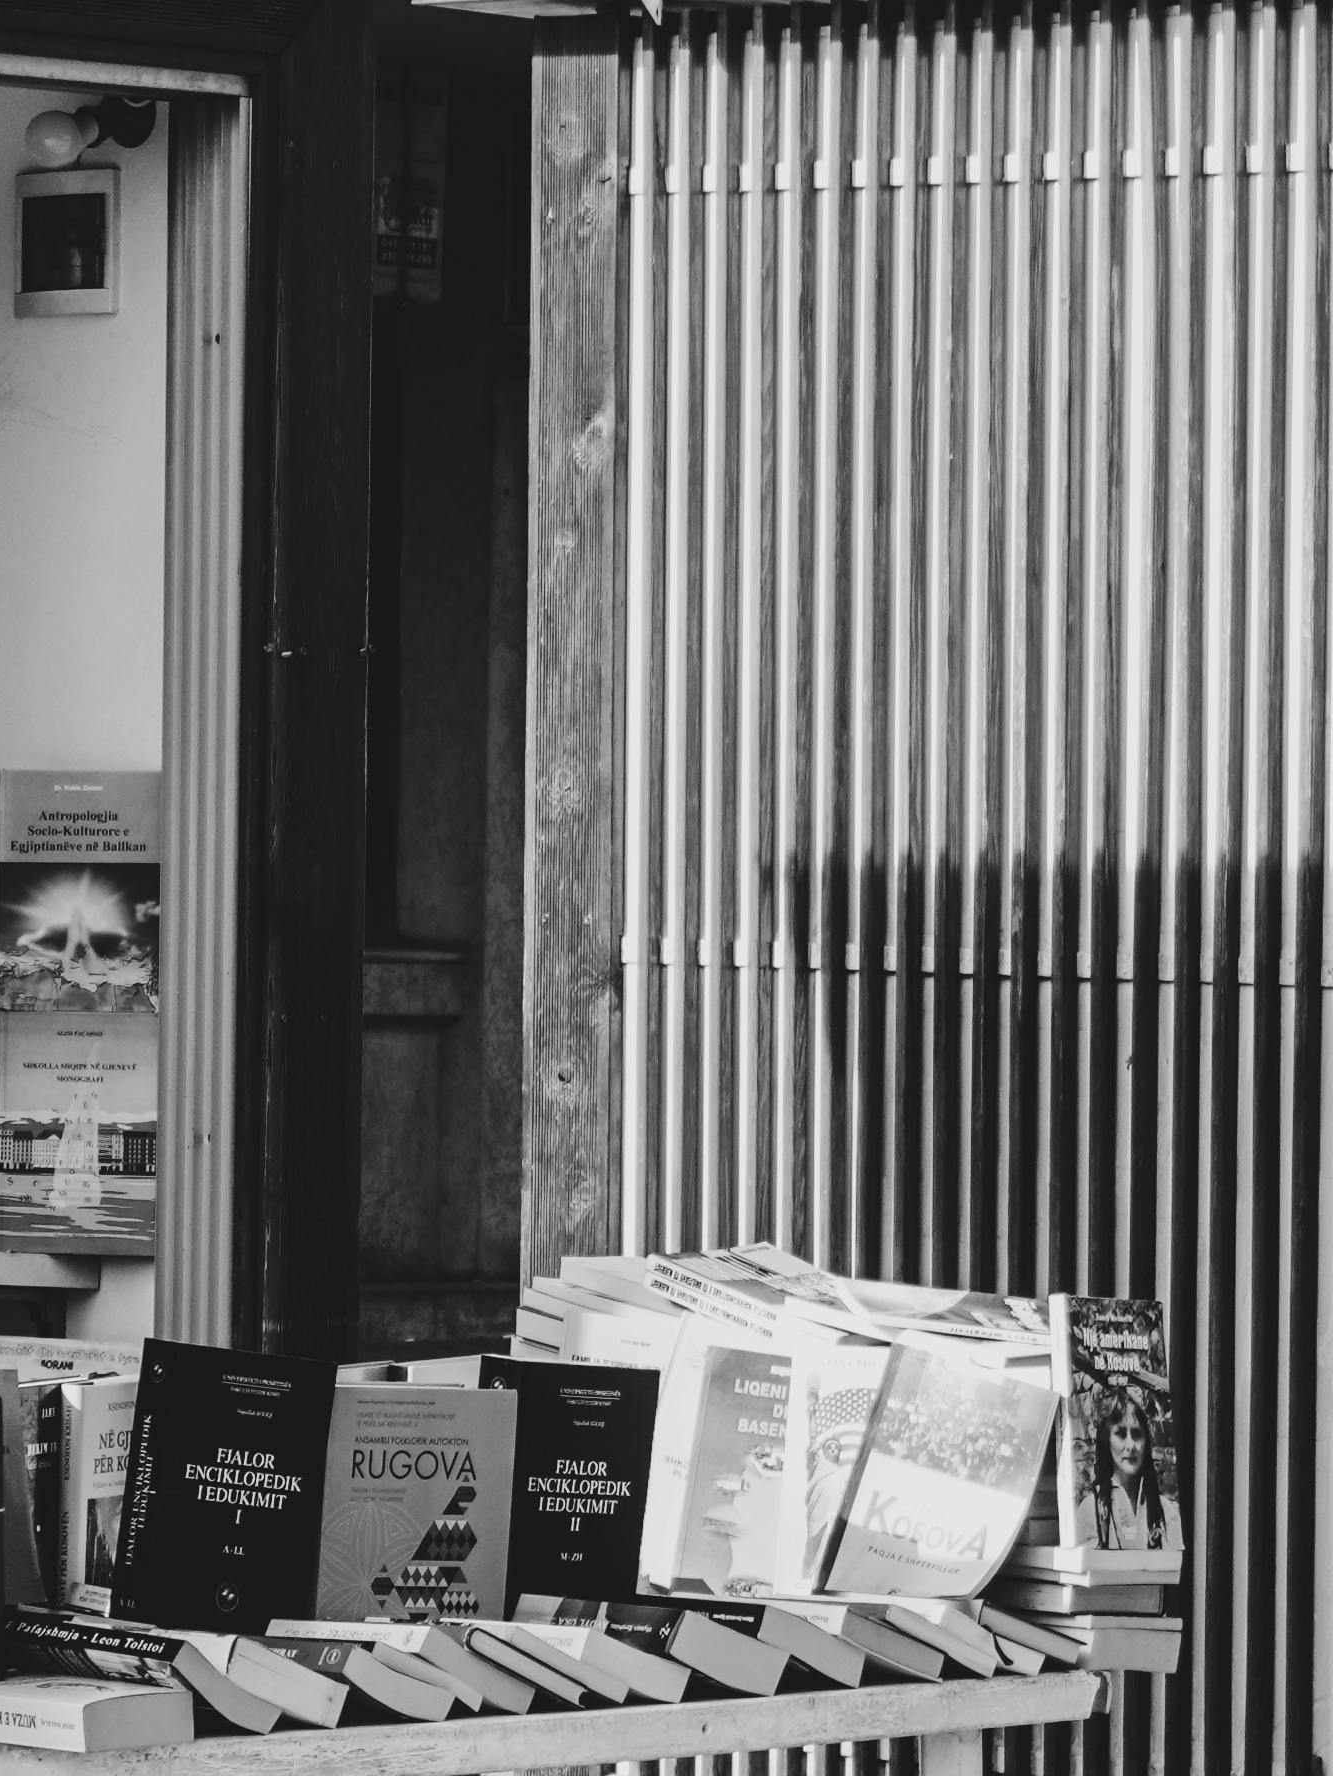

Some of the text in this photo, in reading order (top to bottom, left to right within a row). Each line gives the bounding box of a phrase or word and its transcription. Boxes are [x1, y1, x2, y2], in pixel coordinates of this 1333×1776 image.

[38, 810, 118, 824] Antropologjia
[27, 824, 130, 837] Socio-Kulturore e
[10, 840, 147, 855] Egjiptianëve në Ballkan
[1100, 1331, 1149, 1351] amerikane
[99, 1422, 114, 1444] NË
[428, 1437, 469, 1446] AUTOKTON
[94, 1449, 114, 1468] PËR
[216, 1447, 276, 1470] FJALOR
[351, 1450, 477, 1481] RUGOVA
[556, 1459, 608, 1477] FJALOR
[184, 1463, 303, 1494] ENCIKLOPEDIK
[527, 1477, 631, 1497] ENCIKLOPEDIK
[197, 1484, 288, 1511] I EDUKIMIT
[539, 1497, 619, 1514] I EDUKIMIT
[235, 1508, 242, 1526] I
[570, 1517, 580, 1531] II
[92, 1631, 166, 1654] Leon Tolstoi
